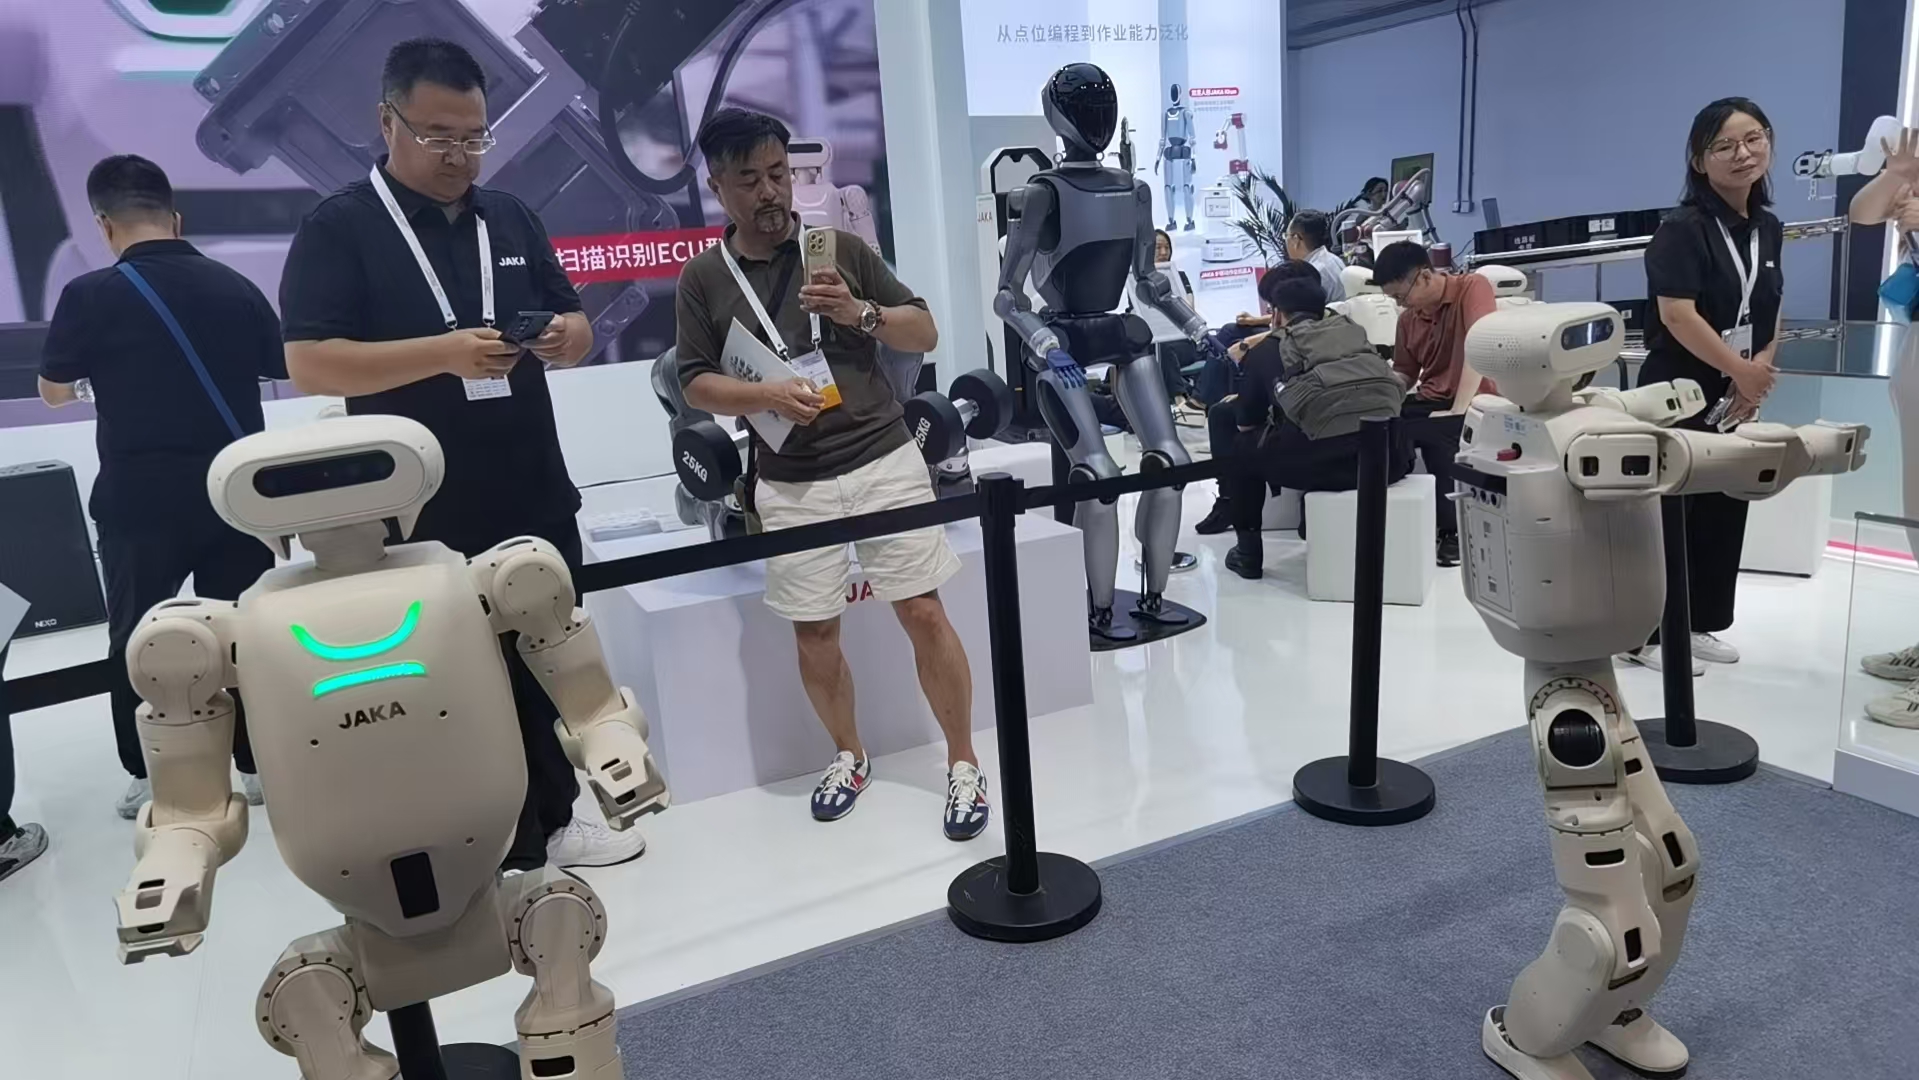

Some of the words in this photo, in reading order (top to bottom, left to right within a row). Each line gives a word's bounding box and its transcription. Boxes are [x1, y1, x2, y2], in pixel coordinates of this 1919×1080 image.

[997, 24, 1188, 43] 从点位编程到作业能力泛化
[499, 256, 526, 267] JAKA
[681, 450, 709, 484] 25KG
[34, 618, 58, 628] NEXO
[338, 701, 407, 730] JAKA
